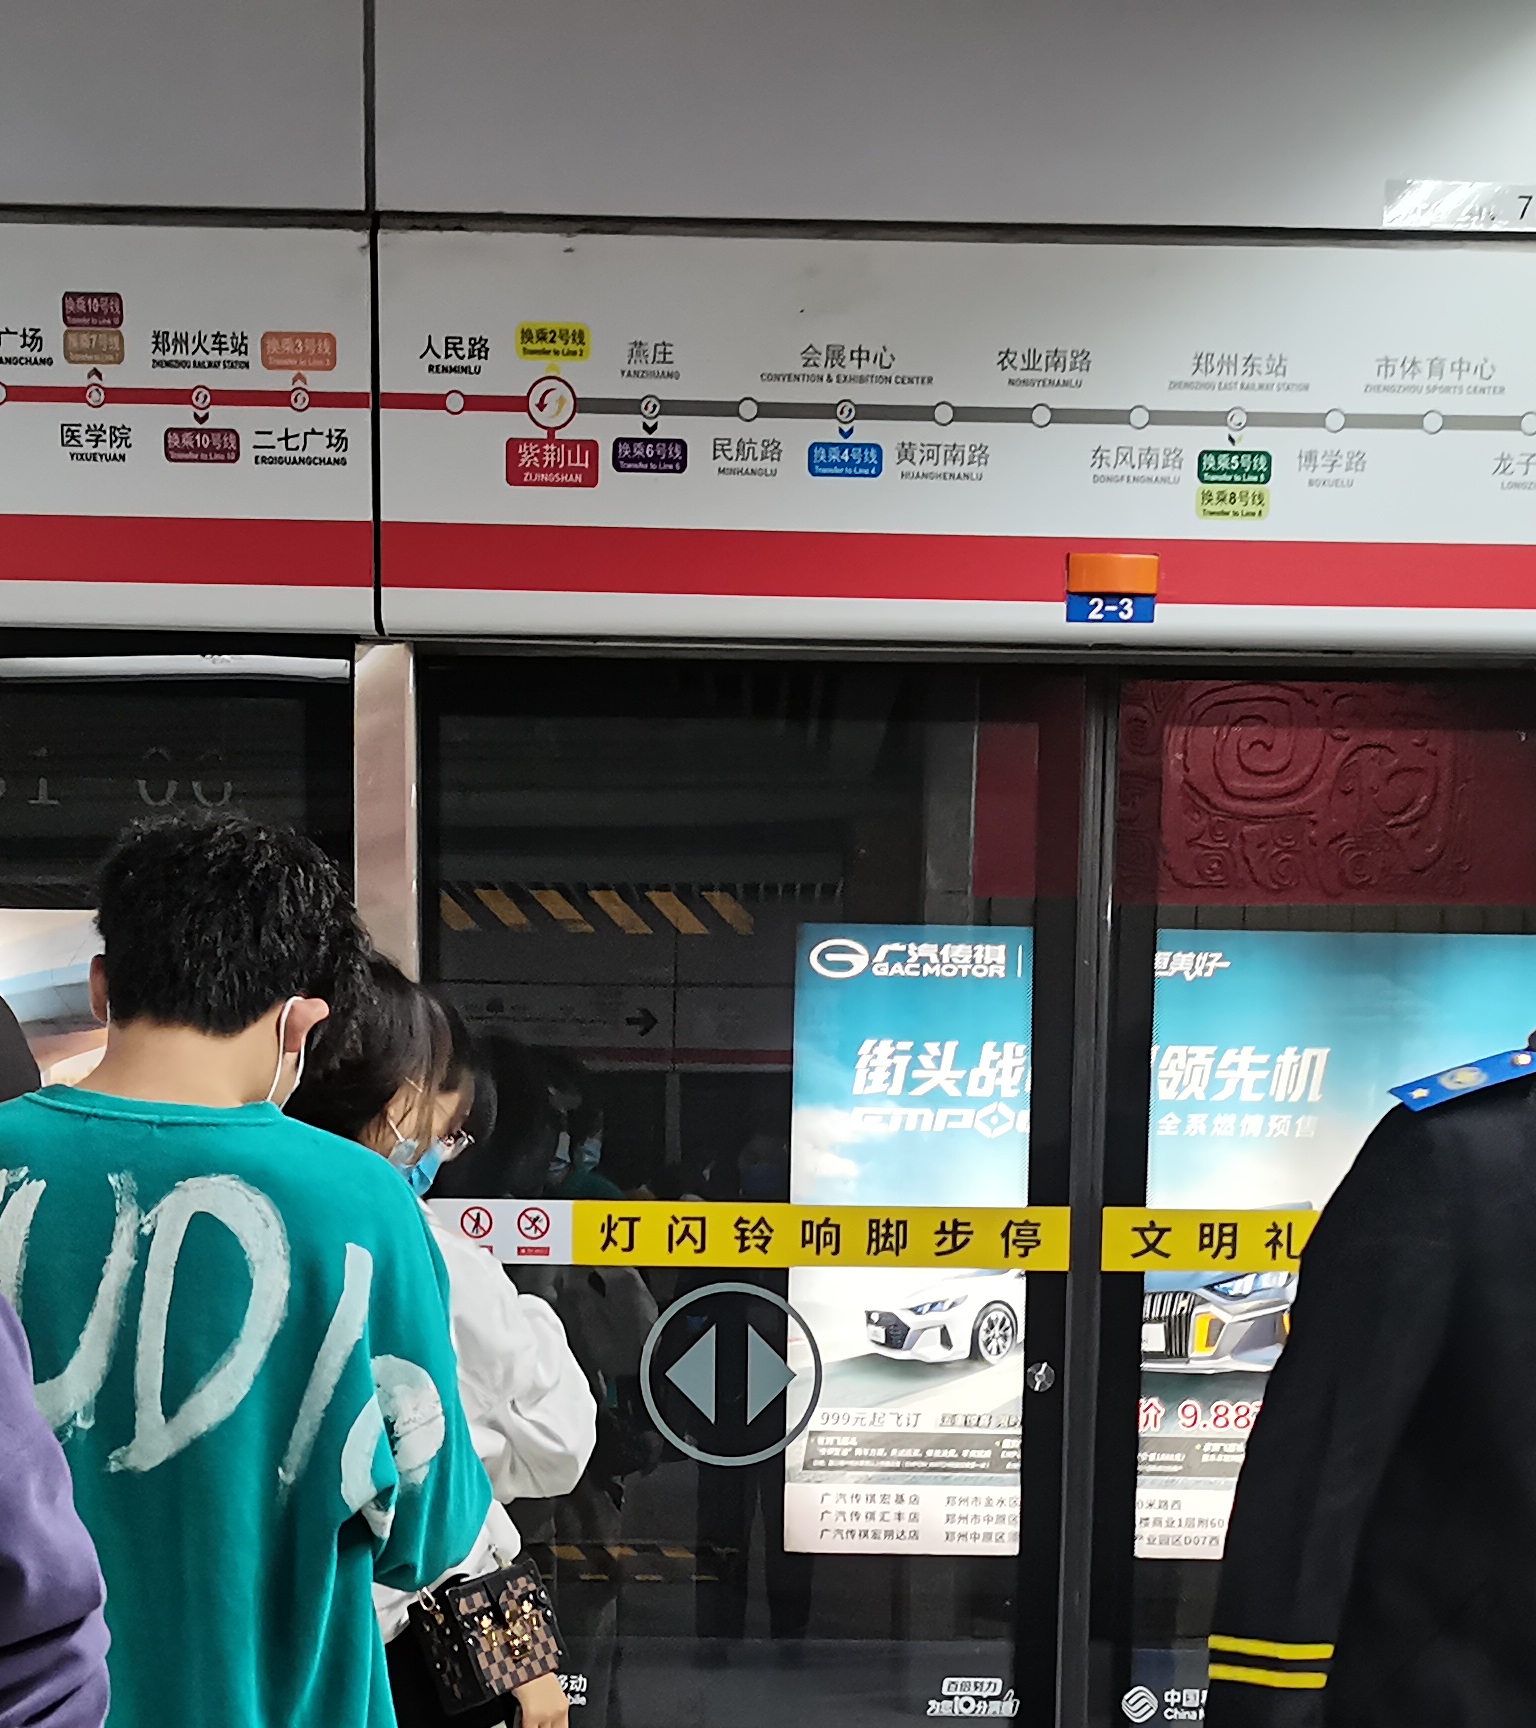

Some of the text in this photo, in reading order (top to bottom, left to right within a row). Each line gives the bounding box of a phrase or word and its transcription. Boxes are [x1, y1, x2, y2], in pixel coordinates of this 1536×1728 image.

[151, 330, 250, 357] 郑州火车站
[266, 336, 332, 356] 换乘3号线
[419, 334, 490, 361] 人民路
[520, 327, 586, 347] 换乘2号线
[627, 340, 675, 366] 燕庄
[800, 343, 896, 369] 会展中心
[997, 347, 1092, 373] 农业南路
[1191, 351, 1288, 378] 郑州东站
[428, 364, 481, 376] RENMINLU
[760, 372, 824, 384] CONVENTION
[894, 375, 933, 386] CENTER
[1375, 354, 1496, 381] 市体育中心
[60, 422, 133, 449] 医学院
[167, 431, 237, 450] 换乘10号线
[252, 427, 349, 453] 二七广场
[69, 451, 126, 463] YIXUEYUAN
[254, 455, 347, 467] ERQIGUANGCHANG
[517, 442, 590, 468] 紫荆山
[617, 441, 683, 461] 换乘6号线
[712, 436, 783, 463] 民航路
[813, 446, 878, 465] 换乘4号线
[895, 440, 990, 467] 黄河南路
[1090, 444, 1183, 470] 东风南路
[1297, 448, 1367, 474] 博学路
[1202, 453, 1268, 473] 换乘5号线
[523, 471, 582, 483] ZIJINGSHAN
[1201, 489, 1265, 508] 换乘8号线
[1088, 597, 1134, 621] 2-3
[872, 942, 1007, 965] 广汽传祺
[852, 1038, 1332, 1102] 街头战 领先机
[600, 1212, 1044, 1260] 灯闪铃响脚步停
[1163, 1707, 1198, 1721] China
